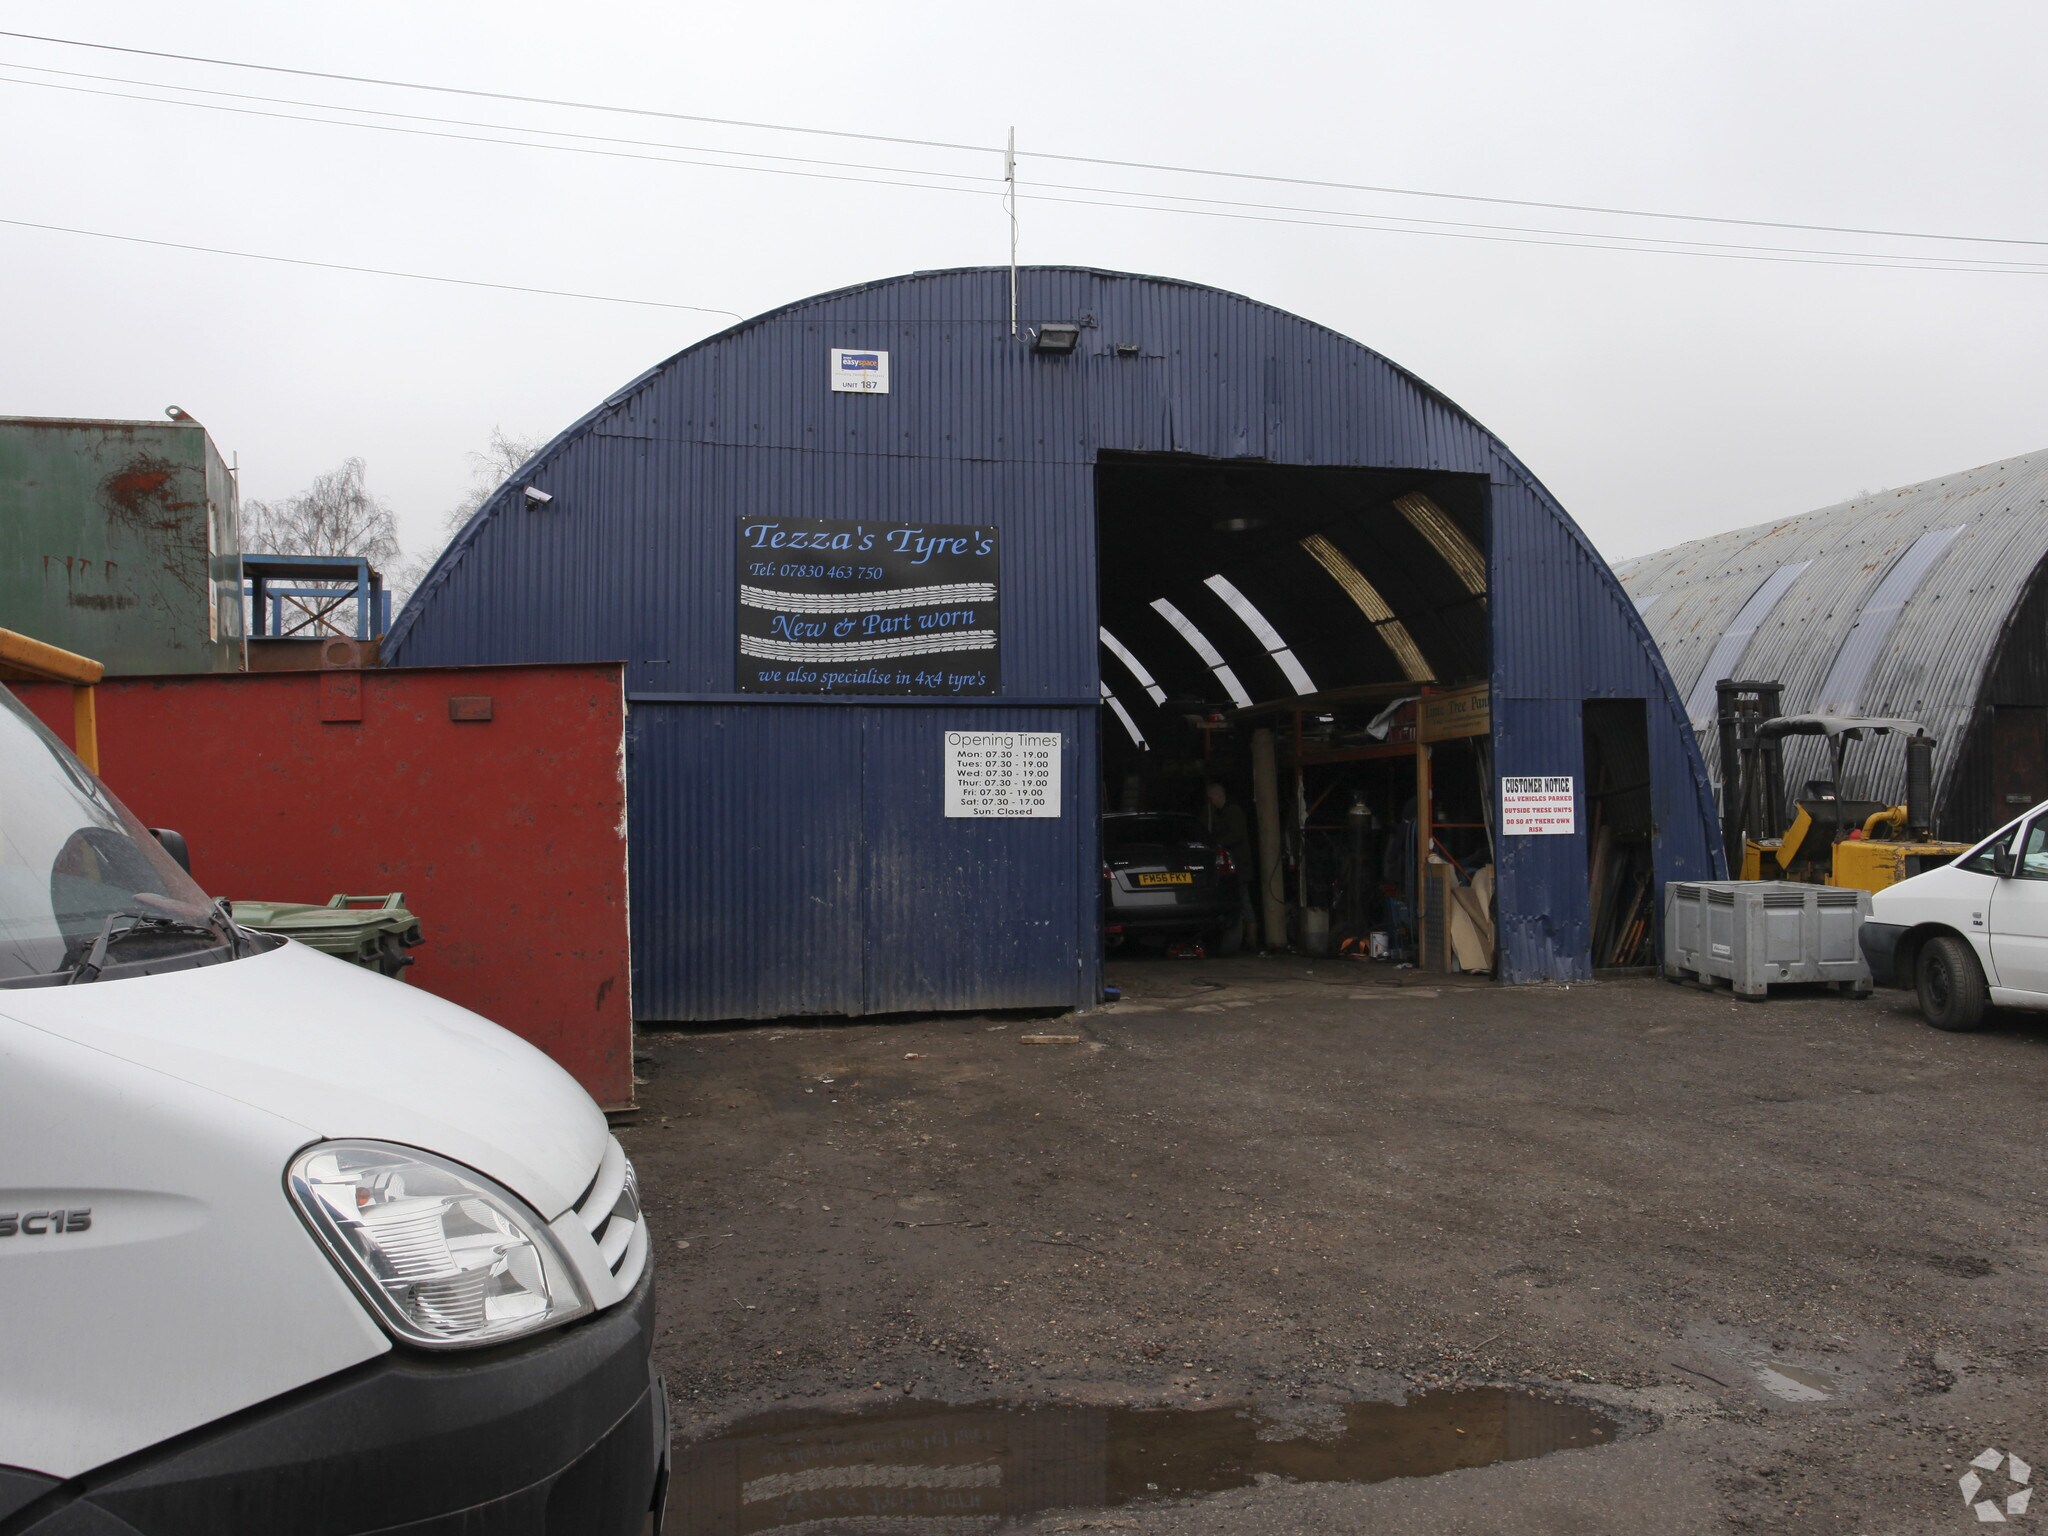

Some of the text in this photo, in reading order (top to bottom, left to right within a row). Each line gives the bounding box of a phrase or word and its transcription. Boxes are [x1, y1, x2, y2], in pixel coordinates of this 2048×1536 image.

[861, 381, 877, 389] 187
[745, 523, 994, 564] Tezza's Tyre's
[750, 562, 883, 580] Tel: 07830 463 750
[770, 610, 975, 641] New & Part worn
[758, 666, 986, 691] we also specialise in 4x4 tyre's
[1449, 701, 1466, 713] Tree
[949, 733, 1057, 749] Opening Times
[1506, 778, 1569, 793] CUSTOMER NOTICE
[1170, 873, 1187, 881] FKY
